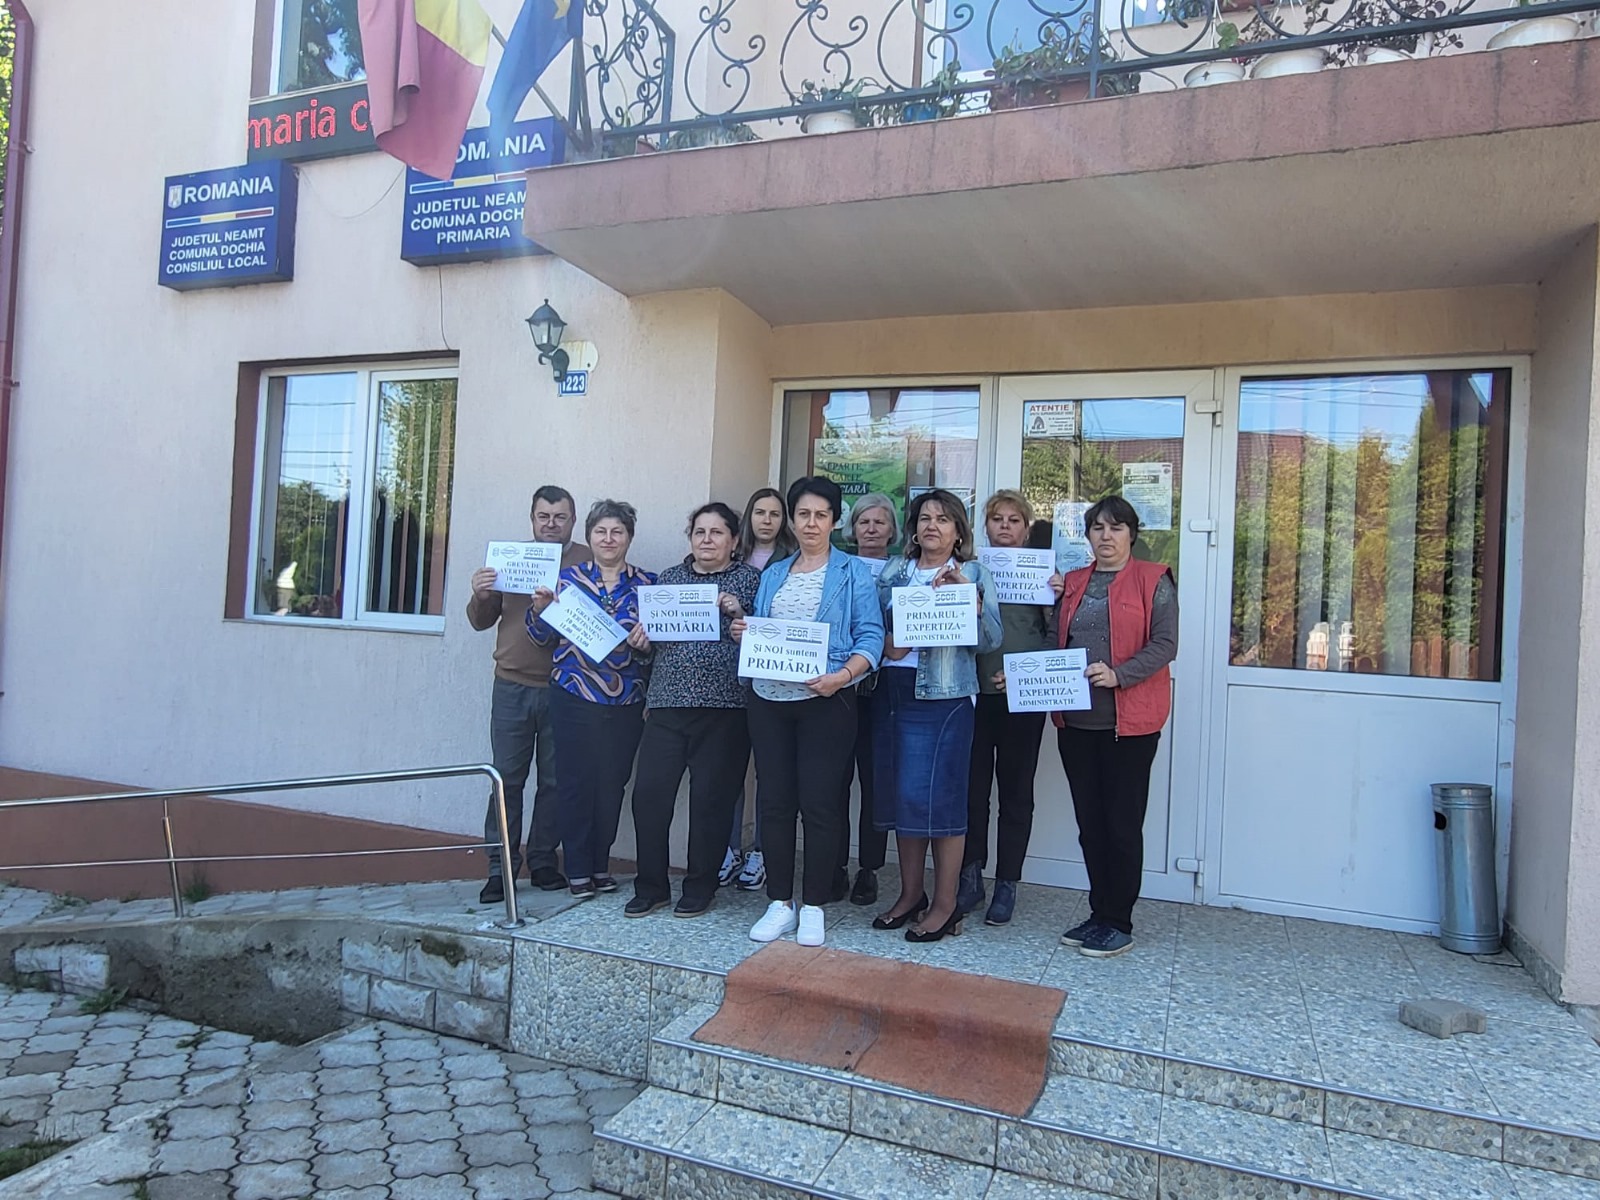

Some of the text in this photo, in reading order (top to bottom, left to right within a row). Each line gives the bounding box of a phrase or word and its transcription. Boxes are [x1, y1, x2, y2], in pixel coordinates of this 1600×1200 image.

[184, 175, 274, 204] ROMANIA
[412, 190, 527, 216] JUDETUL NEAM
[410, 208, 525, 232] COMUNA DOCH
[171, 227, 266, 248] JUDETUL NEAMT
[436, 225, 511, 245] PRIMARIA
[169, 241, 266, 261] COMUNA DOCHIA
[166, 255, 268, 274] CONSILIUL LOCAL
[1029, 404, 1069, 412] ATENTIE
[1017, 555, 1037, 564] SCOR
[994, 581, 1045, 590] XPERTIZA=
[679, 591, 700, 601] SCOR
[935, 592, 957, 602] SCOR
[996, 591, 1036, 602] OLITICĂ
[660, 609, 679, 618] NOI
[680, 610, 711, 618] suntem
[905, 610, 959, 621] PRIMARUL
[646, 619, 716, 633] PRIMĂRIA
[786, 628, 809, 639] SCOR
[764, 644, 783, 655] NOI
[785, 648, 818, 659] suntem
[747, 656, 821, 675] PRIMĂRIA
[1045, 657, 1067, 667] SCOR
[1017, 676, 1069, 686] PRIMARUL
